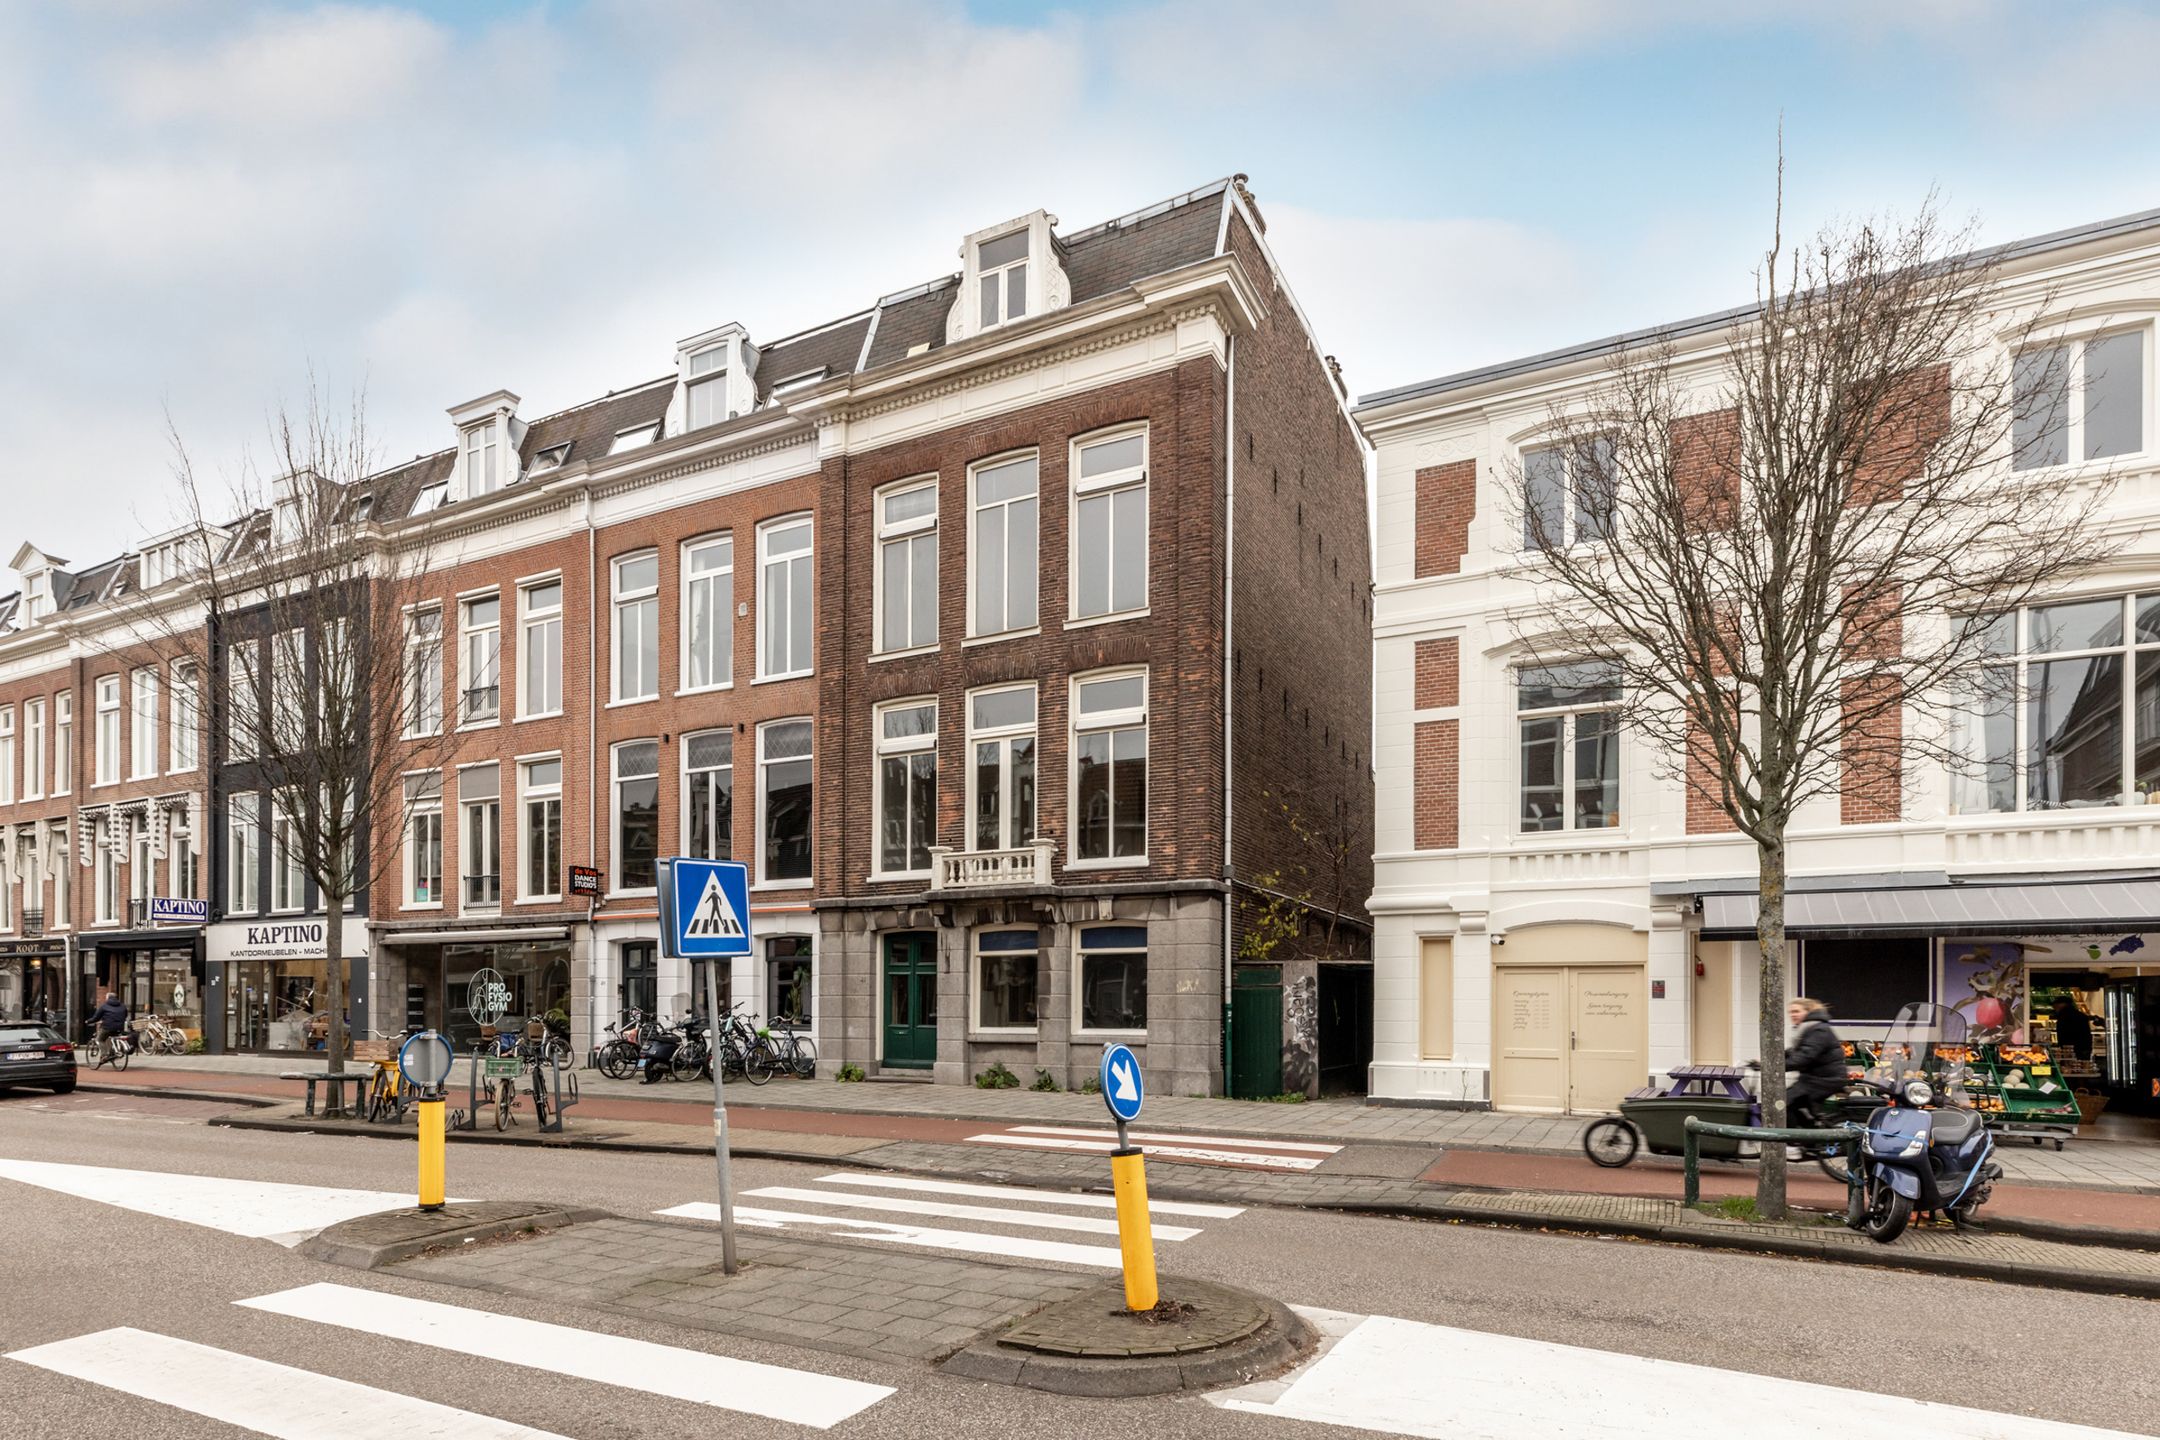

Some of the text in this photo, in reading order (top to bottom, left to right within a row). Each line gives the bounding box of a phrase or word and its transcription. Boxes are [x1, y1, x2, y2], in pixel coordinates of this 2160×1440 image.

[574, 874, 597, 882] DANCE
[154, 899, 205, 914] KAPTINO
[247, 924, 322, 945] KAPTINO
[16, 944, 39, 953] KOOT
[488, 982, 506, 993] PRO
[488, 992, 512, 1002] FYSIO
[488, 1001, 508, 1011] GYM
